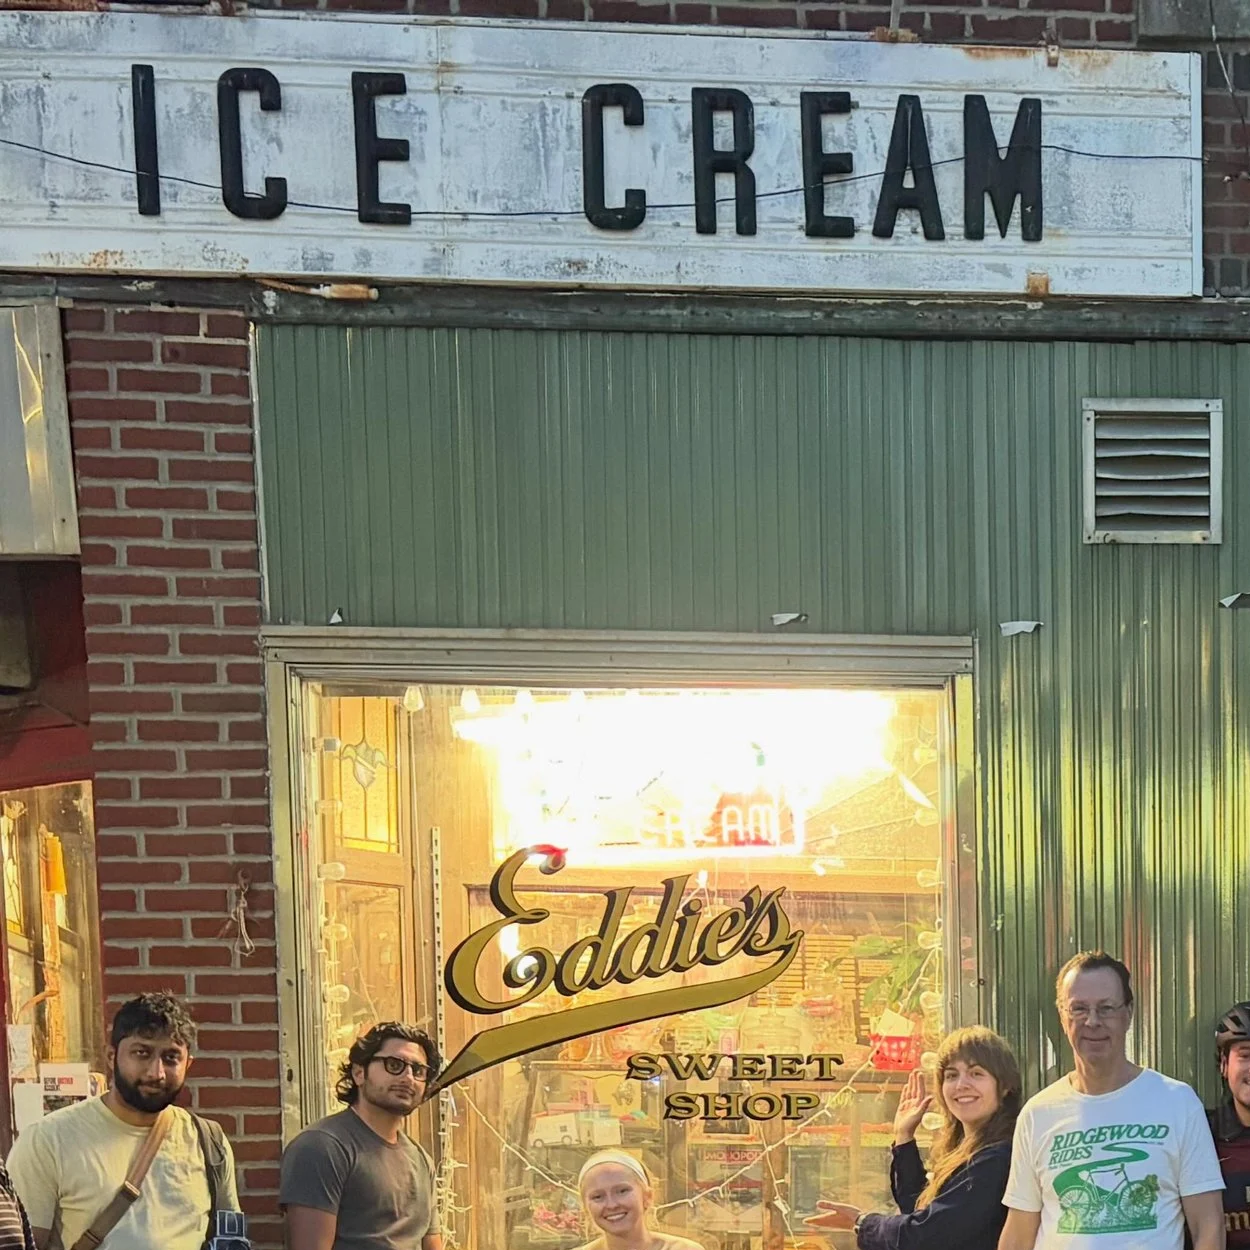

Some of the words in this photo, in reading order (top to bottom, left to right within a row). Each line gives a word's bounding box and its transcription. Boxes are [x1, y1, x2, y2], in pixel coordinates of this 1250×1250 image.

[131, 63, 412, 225] ICE
[581, 82, 1045, 243] CREAM
[444, 843, 797, 1015] Eddie's
[625, 1053, 843, 1082] SWEET
[662, 1092, 821, 1121] SHOP
[1050, 1124, 1170, 1153] RIDGEWOOD
[1048, 1145, 1093, 1167] RIDES
